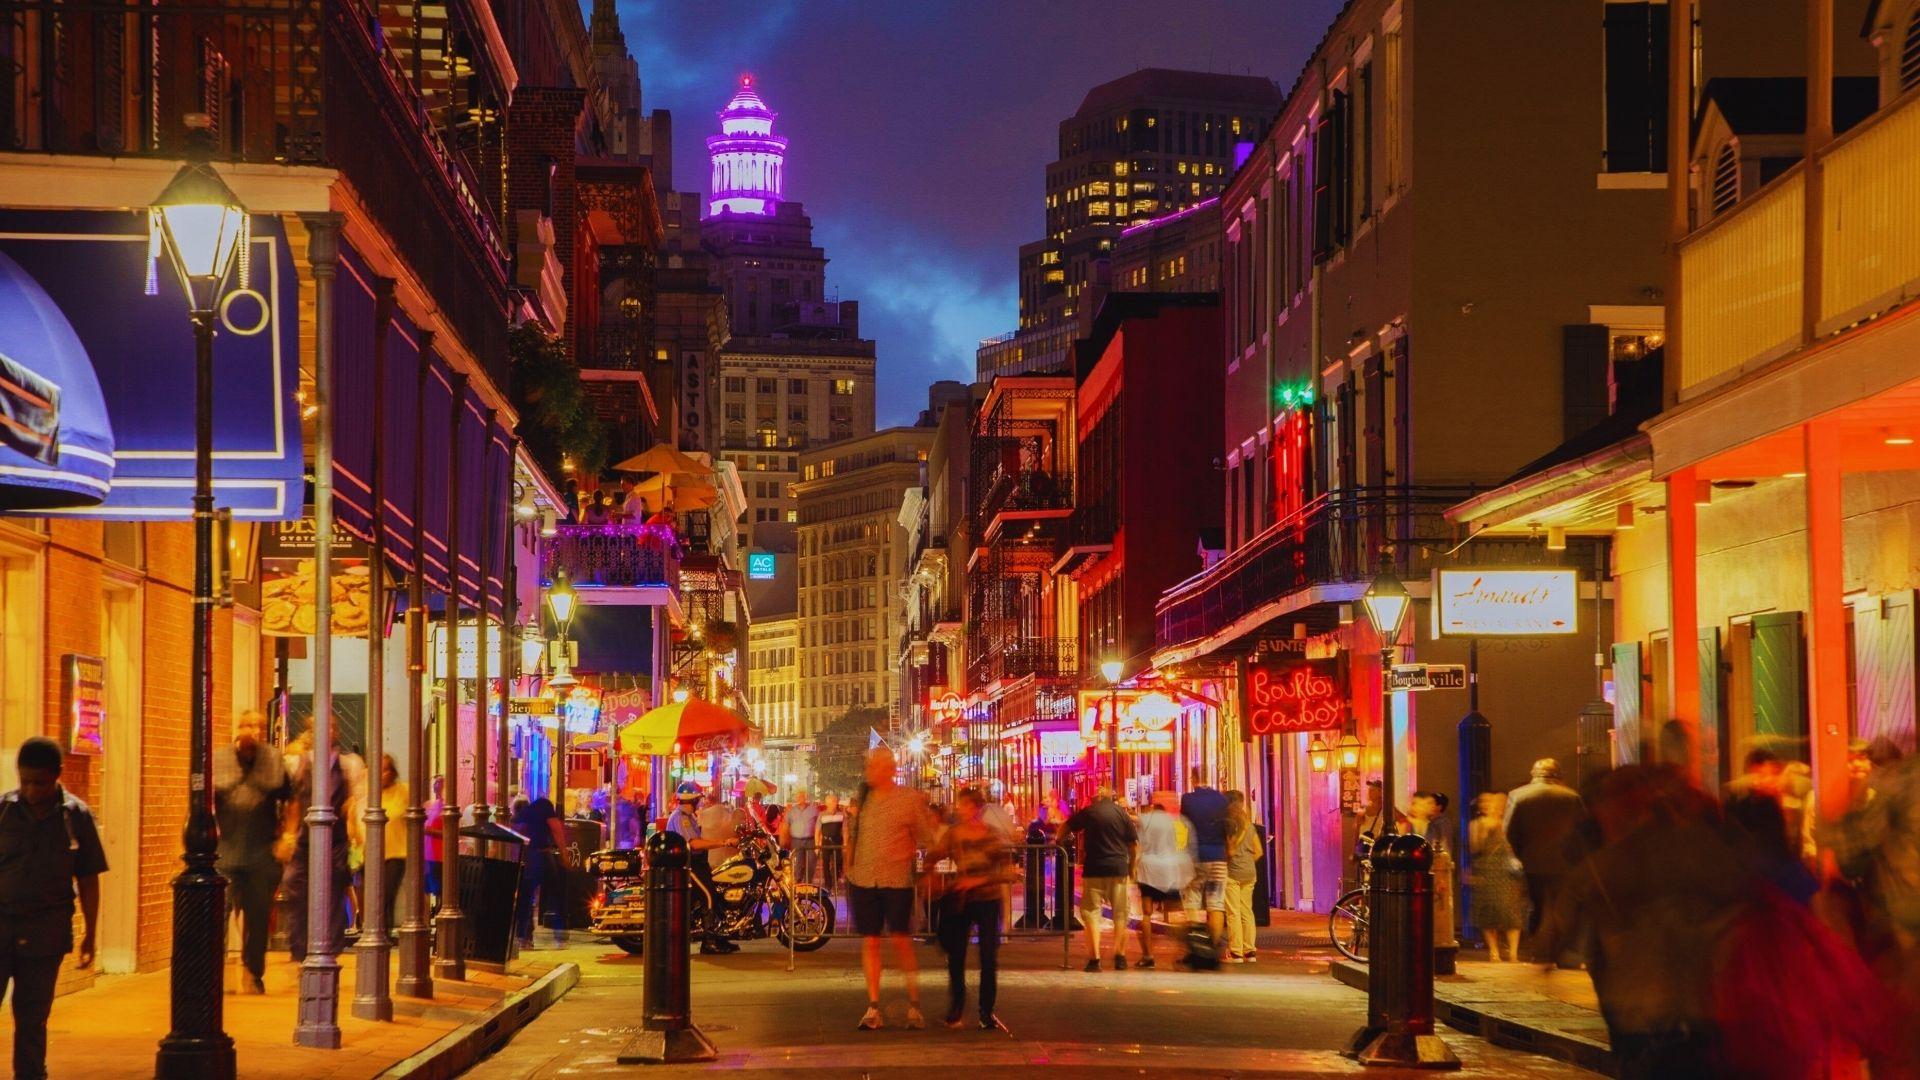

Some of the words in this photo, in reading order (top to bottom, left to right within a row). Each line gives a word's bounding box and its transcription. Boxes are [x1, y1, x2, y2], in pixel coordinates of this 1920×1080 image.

[753, 557, 772, 568] AC
[1392, 673, 1428, 687] Bourbon
[1428, 673, 1464, 686] ville
